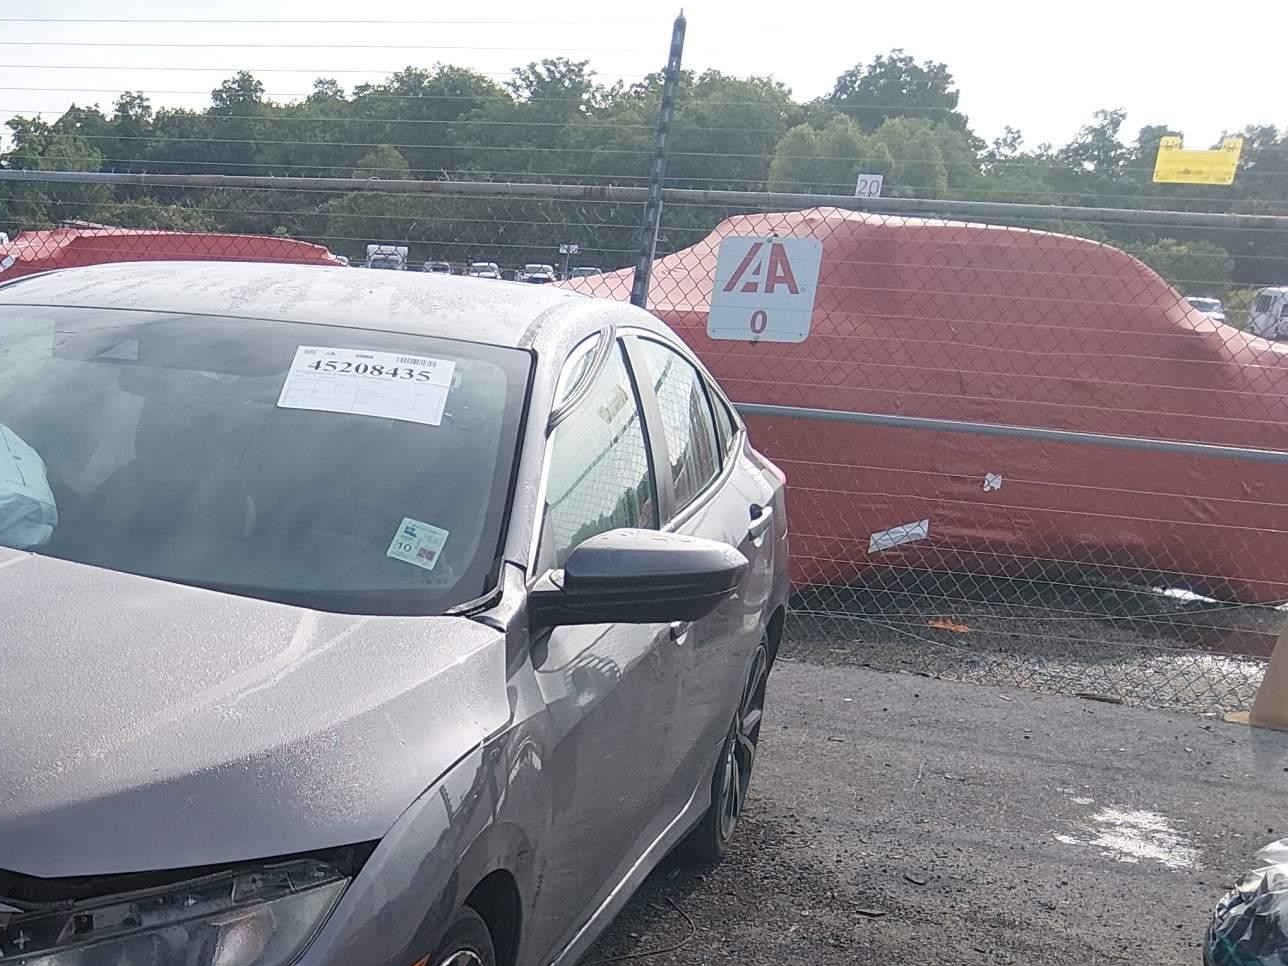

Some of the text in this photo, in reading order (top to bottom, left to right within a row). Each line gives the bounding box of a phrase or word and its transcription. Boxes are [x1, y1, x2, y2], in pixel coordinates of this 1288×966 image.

[857, 179, 880, 195] 20
[750, 310, 768, 334] 0
[307, 359, 432, 382] 45208435
[398, 542, 411, 552] 10
